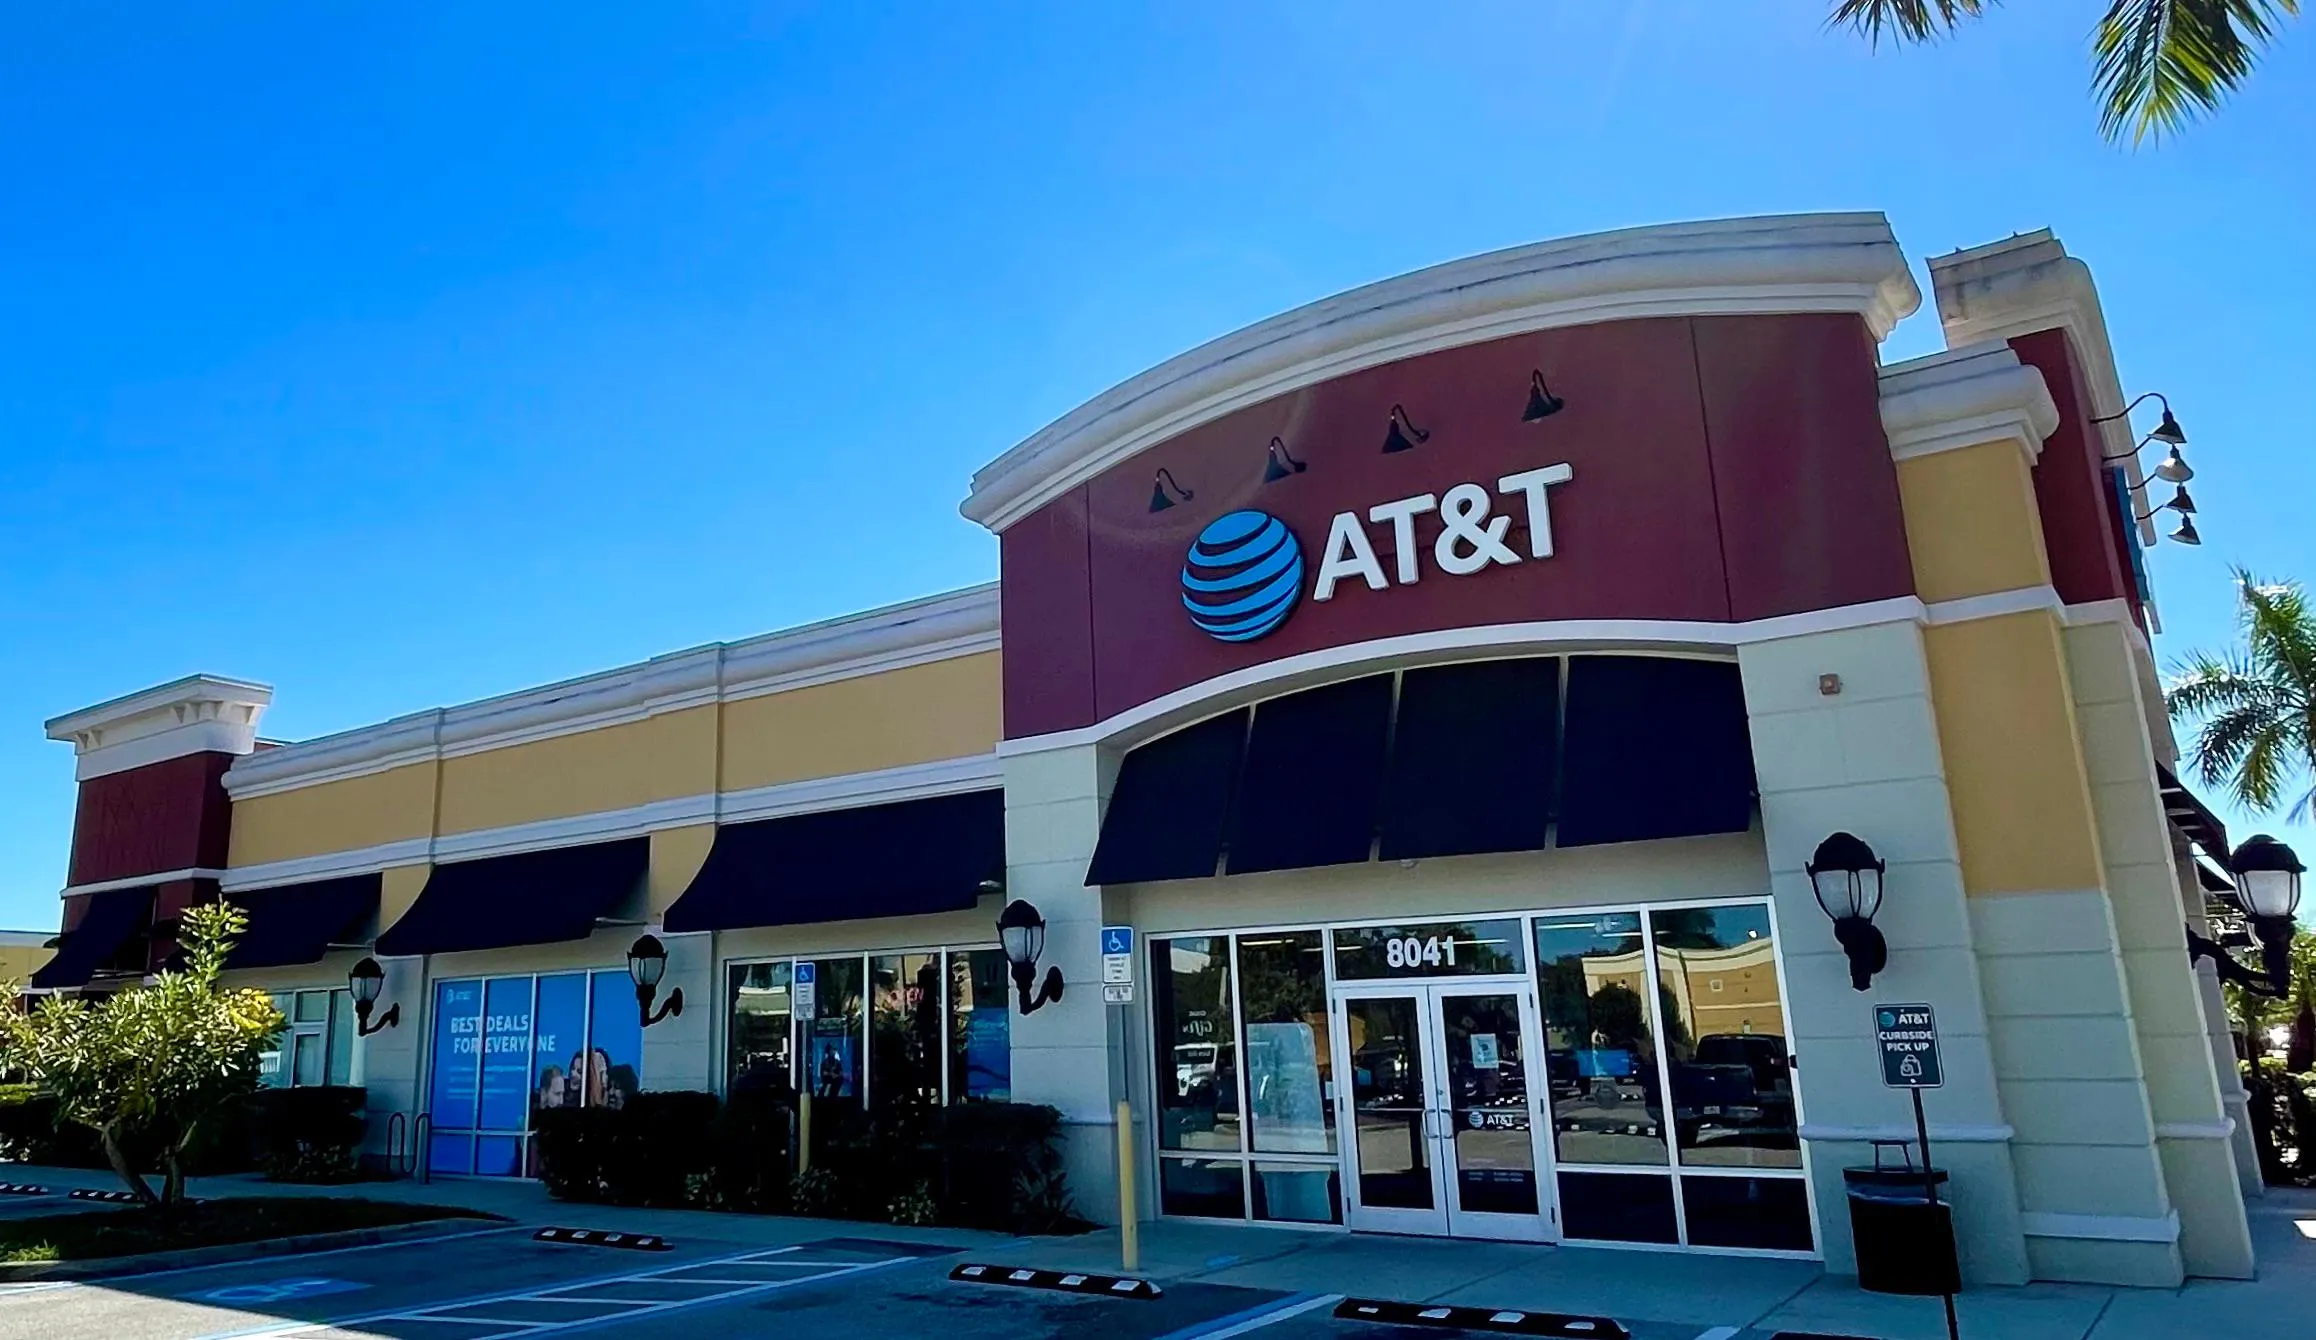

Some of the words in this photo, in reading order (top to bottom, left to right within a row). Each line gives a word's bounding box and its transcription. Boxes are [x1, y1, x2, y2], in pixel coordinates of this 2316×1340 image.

[1313, 462, 1573, 602] AT&T
[1386, 935, 1456, 968] 8041
[486, 1014, 529, 1033] DEALS
[1898, 1013, 1929, 1025] AT&T
[1880, 1031, 1934, 1040] CURBSIDE
[1886, 1042, 1912, 1052] PICK
[1913, 1042, 1930, 1051] UP
[1486, 1114, 1514, 1125] AT&T
